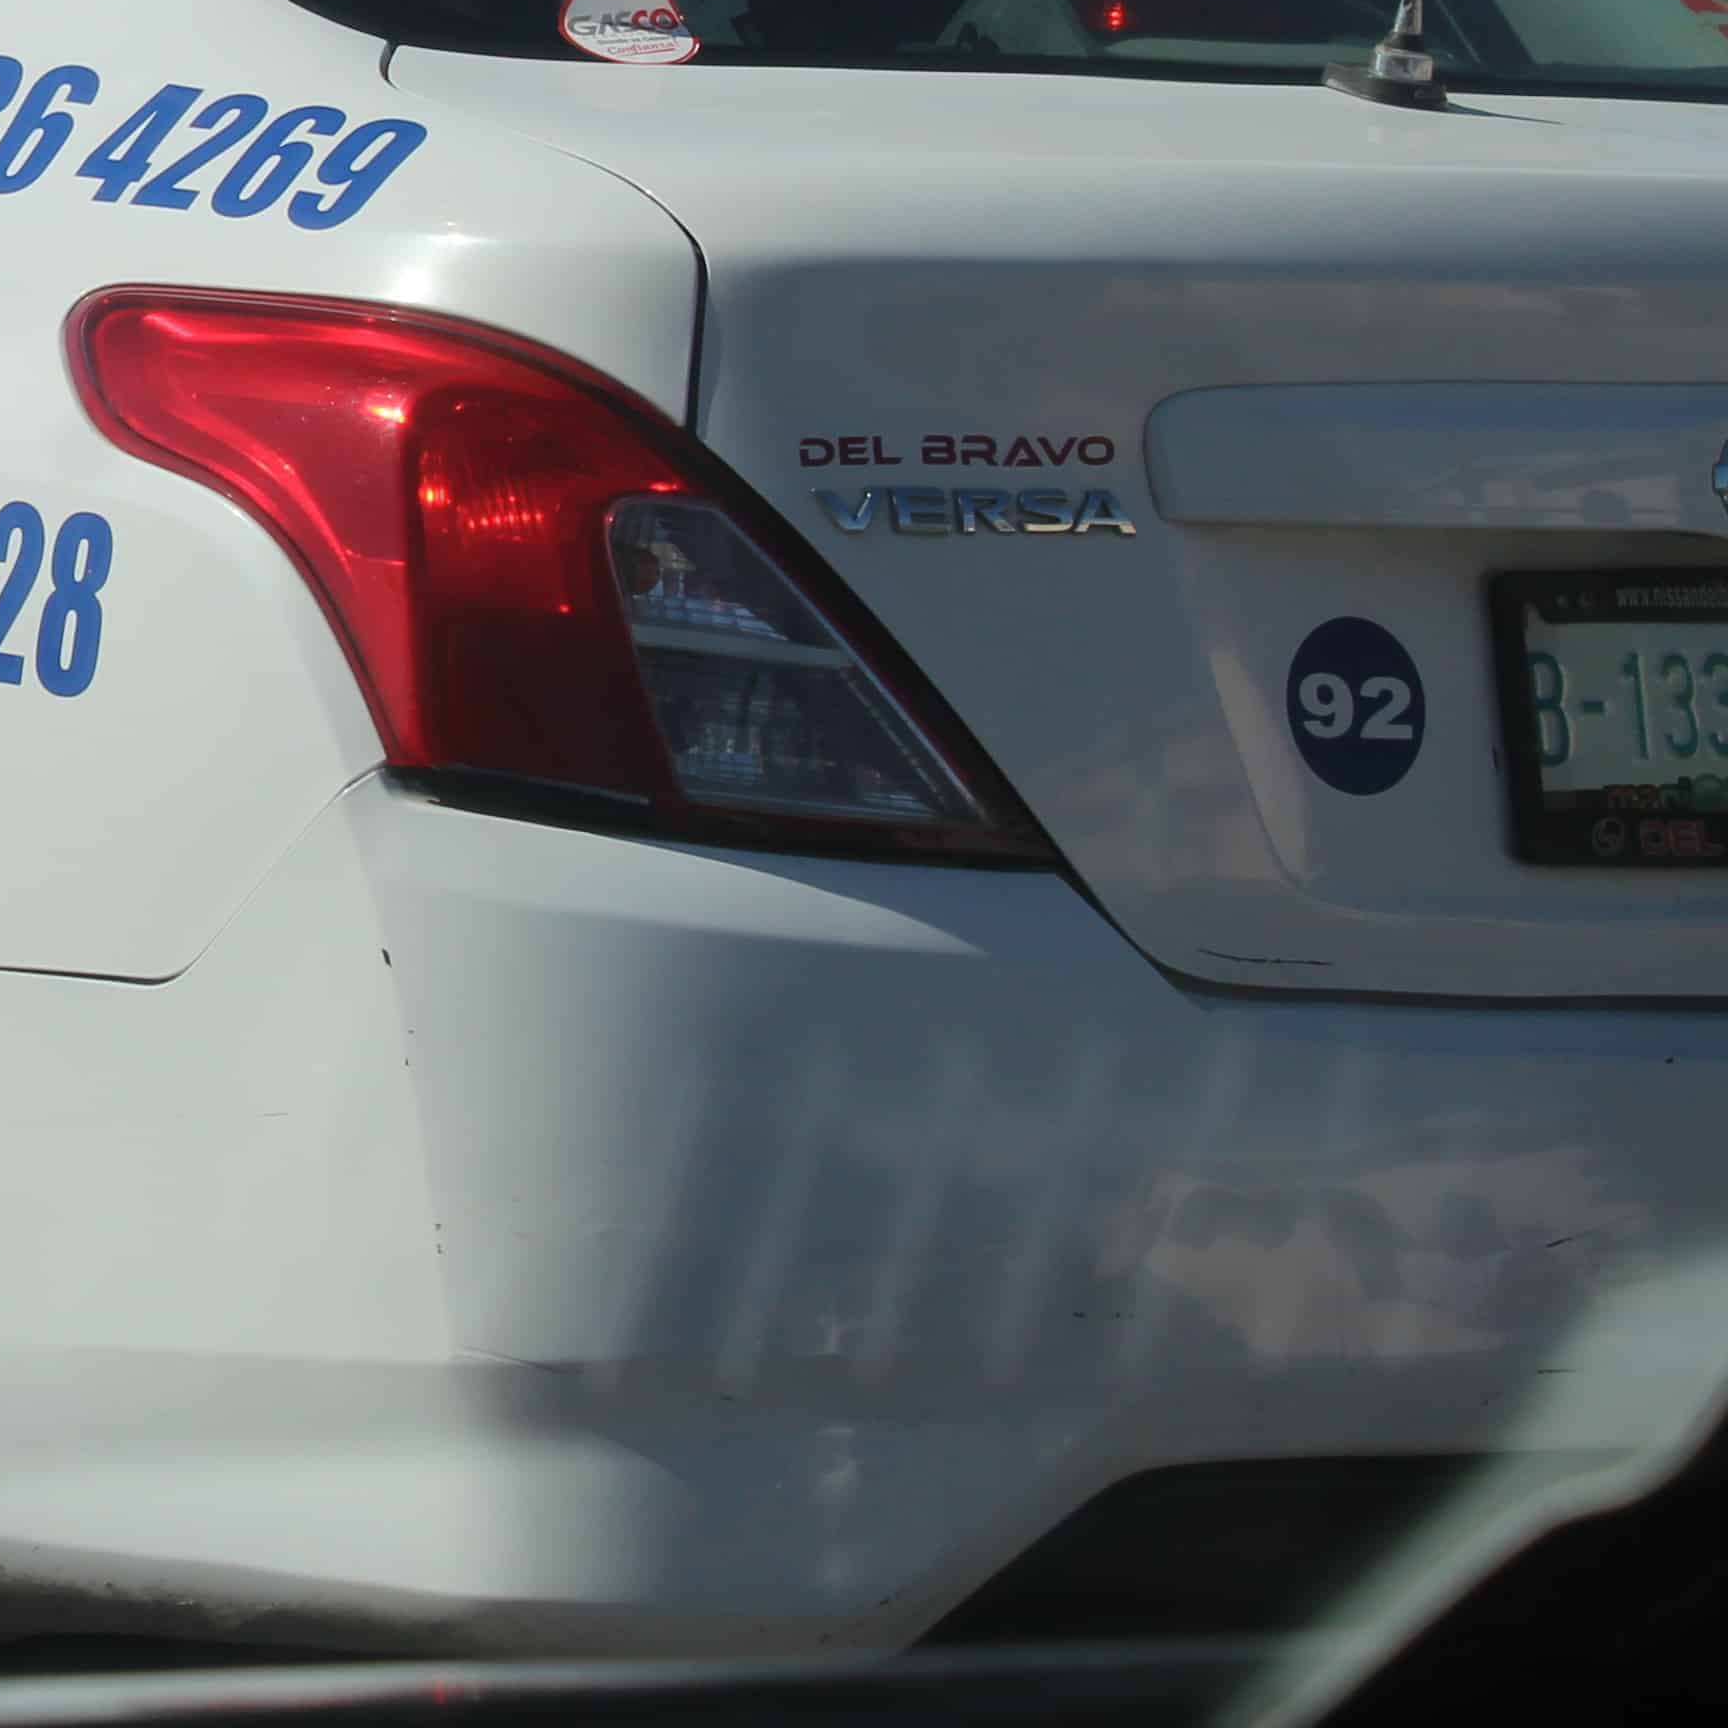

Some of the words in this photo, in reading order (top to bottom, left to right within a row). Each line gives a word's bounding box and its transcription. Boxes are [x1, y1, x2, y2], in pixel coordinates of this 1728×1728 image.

[568, 8, 679, 37] GASCO
[75, 83, 428, 231] 4269
[799, 435, 903, 468] DEL
[921, 434, 1116, 467] BRAVO
[810, 485, 1137, 537] VERSA
[1299, 672, 1413, 740] 92
